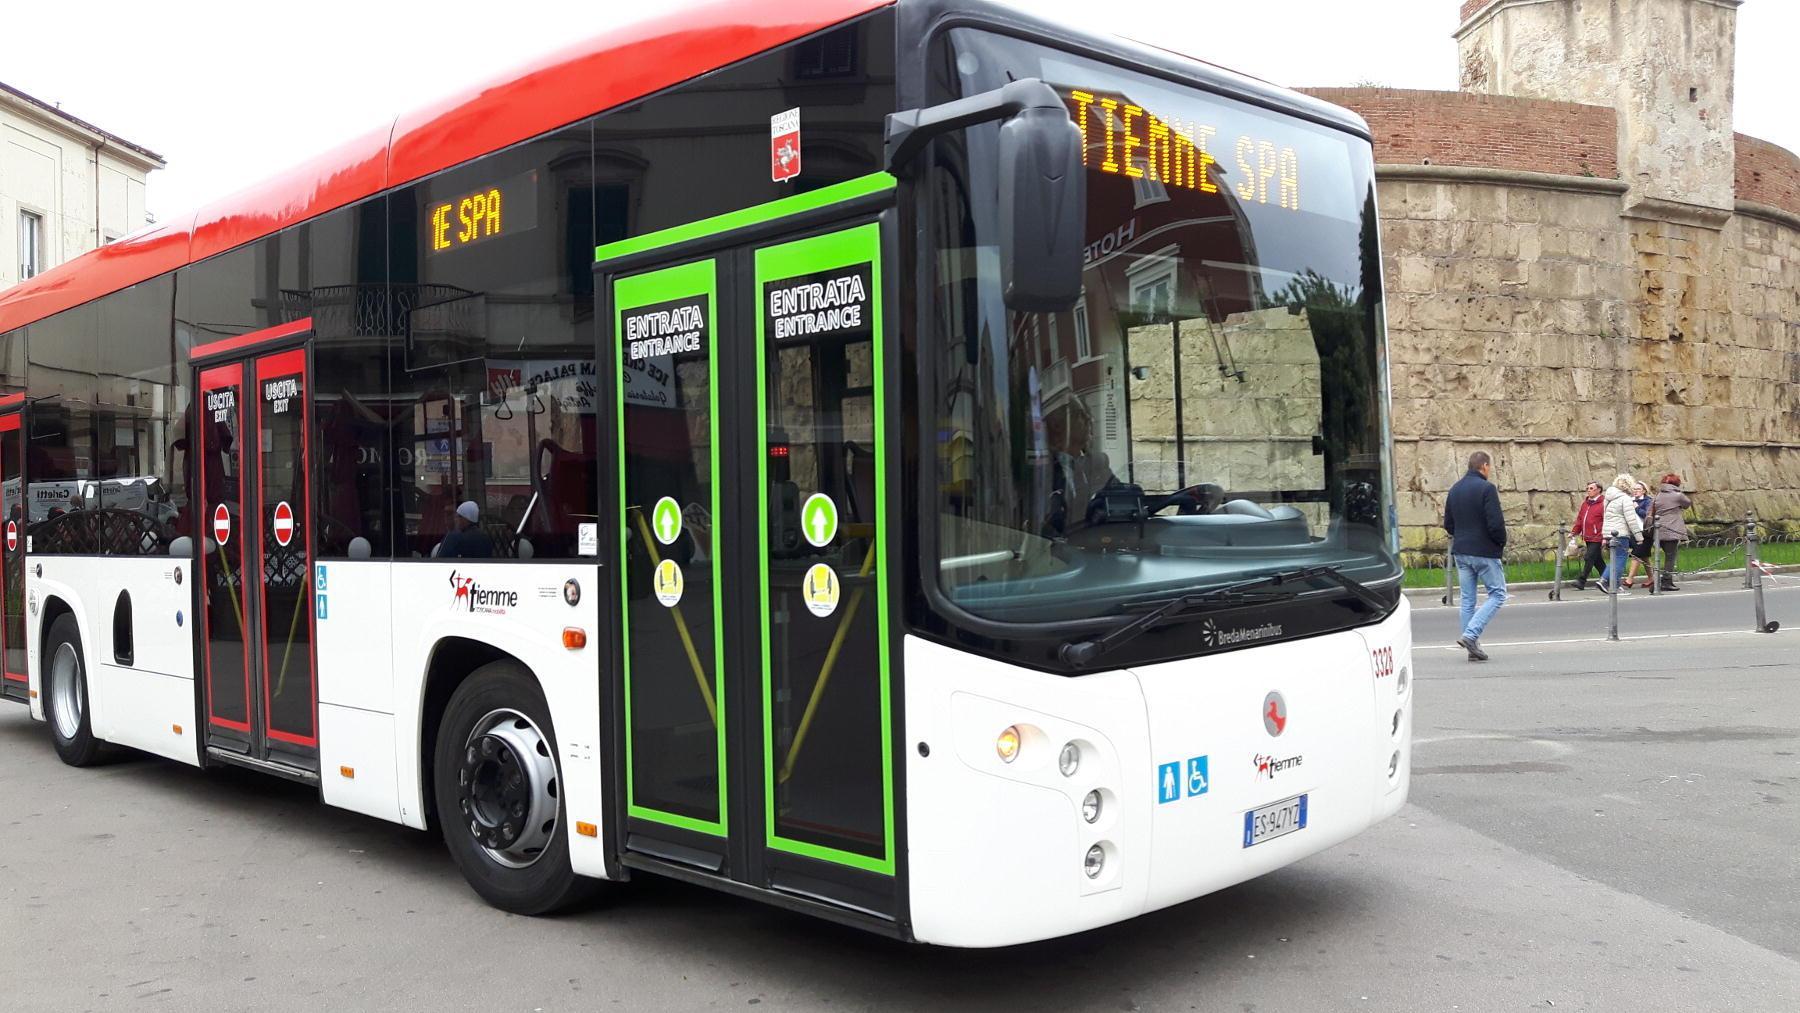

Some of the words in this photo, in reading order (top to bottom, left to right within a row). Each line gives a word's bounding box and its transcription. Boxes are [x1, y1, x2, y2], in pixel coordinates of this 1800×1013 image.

[1072, 90, 1217, 194] TIEMME
[1236, 135, 1298, 211] SPA
[459, 189, 500, 243] SPA
[770, 274, 866, 317] ENTRATA
[626, 305, 703, 340] ENTRATA
[775, 305, 862, 339] ENTRANCE
[631, 332, 700, 360] ENTRANCE
[207, 391, 234, 410] USCITA
[265, 379, 297, 400] USCITA
[214, 409, 227, 423] EXIT
[273, 398, 289, 413] EXIT
[469, 581, 518, 613] tiemme
[1218, 623, 1282, 645] BredaMenarinibus
[1373, 645, 1393, 679] 3328
[1269, 755, 1303, 779] tiemme
